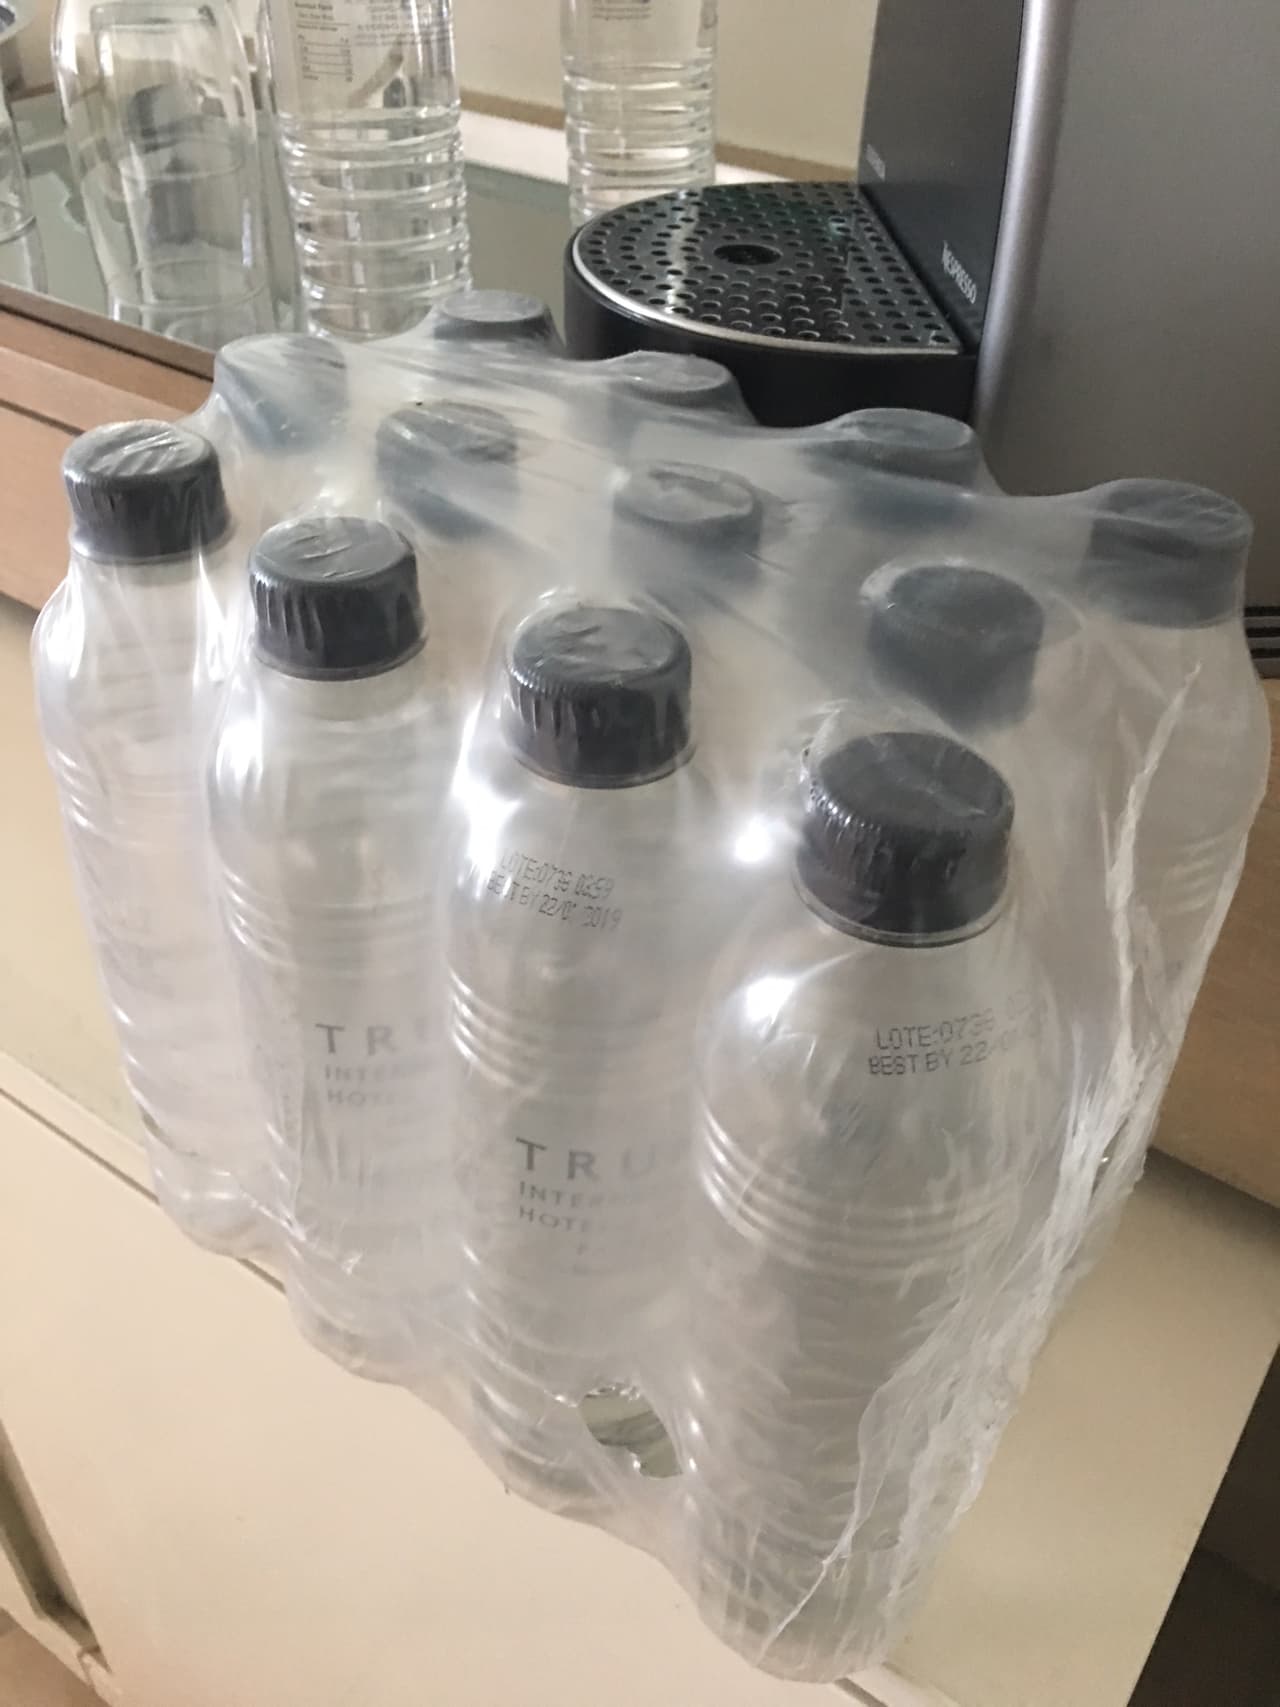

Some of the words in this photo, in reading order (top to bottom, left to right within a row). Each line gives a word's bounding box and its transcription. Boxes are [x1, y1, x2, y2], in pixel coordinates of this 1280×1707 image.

[487, 869, 521, 901] BET
[868, 1053, 918, 1076] BEST
[925, 1049, 954, 1073] BY
